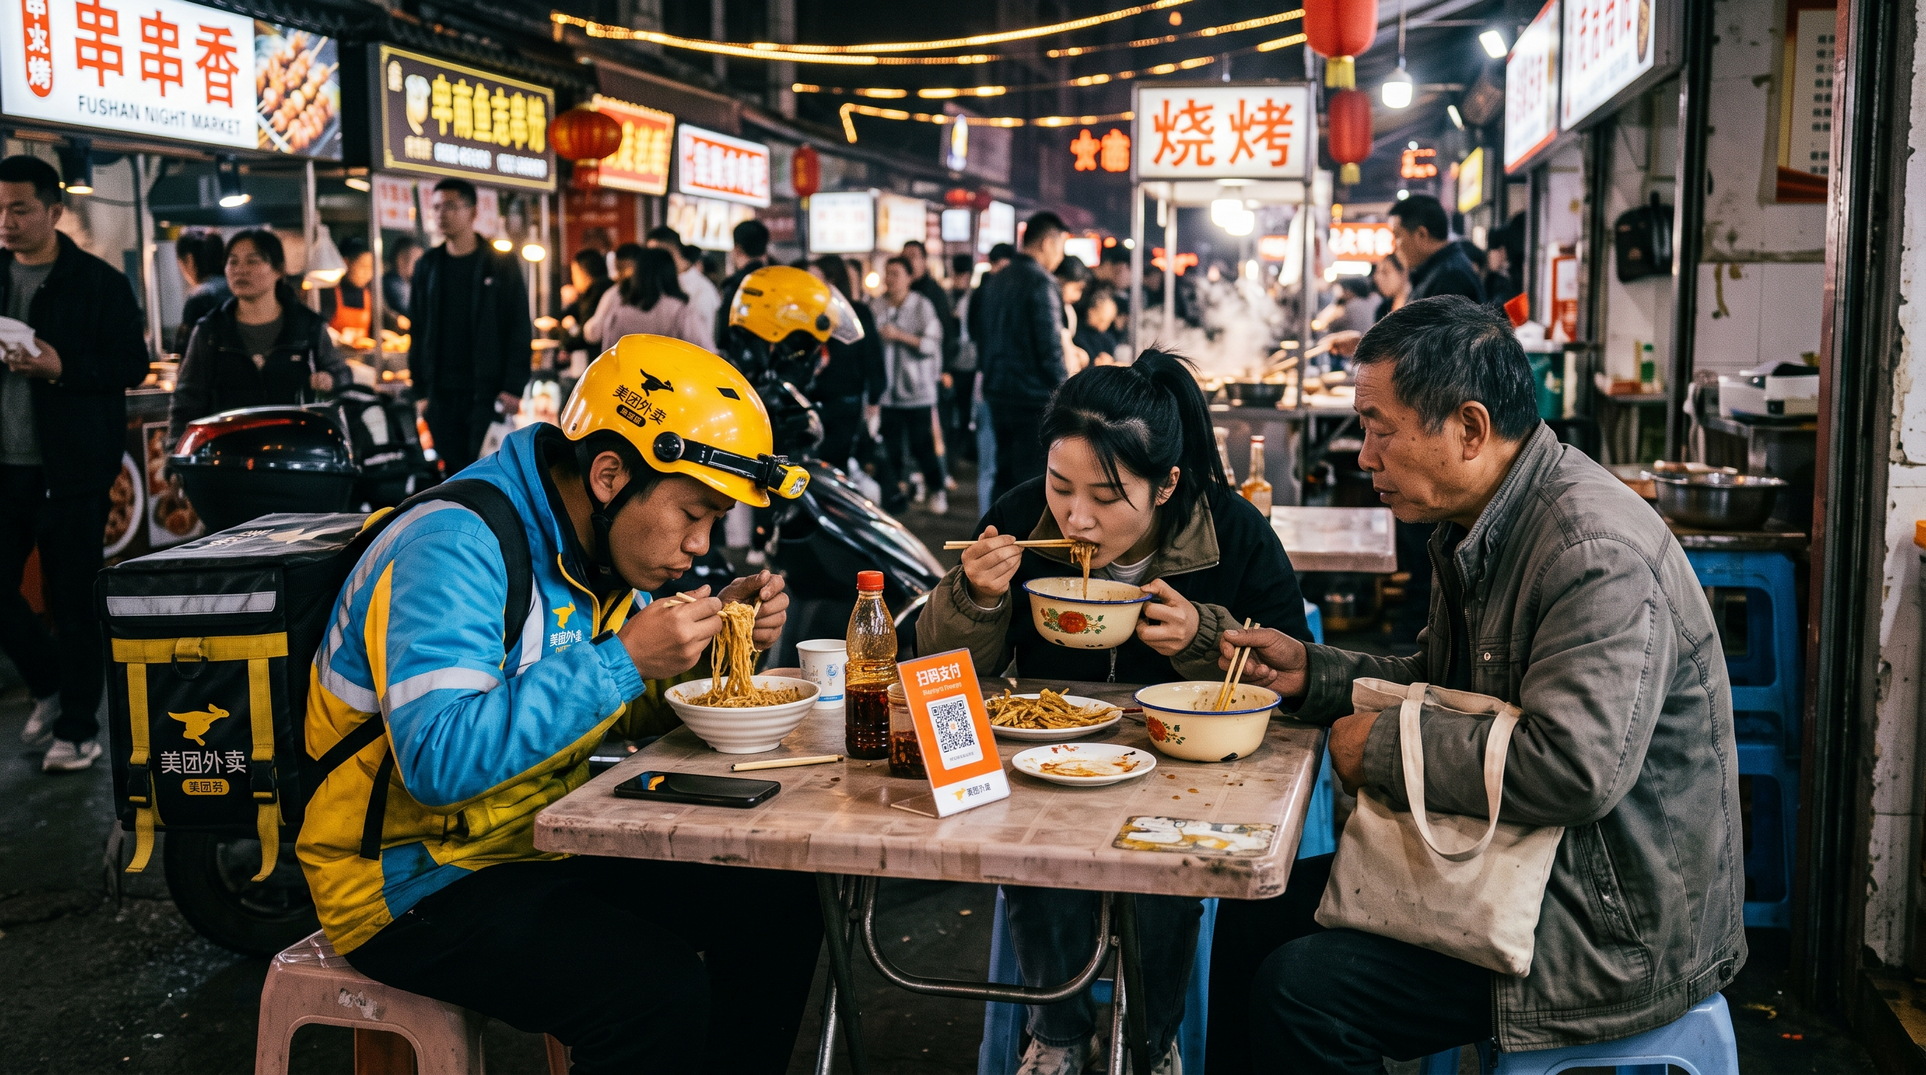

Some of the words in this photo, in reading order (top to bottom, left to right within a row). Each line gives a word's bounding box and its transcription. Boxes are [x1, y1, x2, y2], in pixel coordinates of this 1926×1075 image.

[75, 0, 240, 108] 串串香
[78, 95, 140, 120] FUSHAN
[145, 106, 186, 128] NIGHT
[191, 113, 241, 136] MARKET
[1152, 98, 1294, 168] 烧烤
[612, 384, 667, 426] 美团外卖
[916, 662, 962, 687] 扫码支付
[160, 749, 247, 775] 美团外卖
